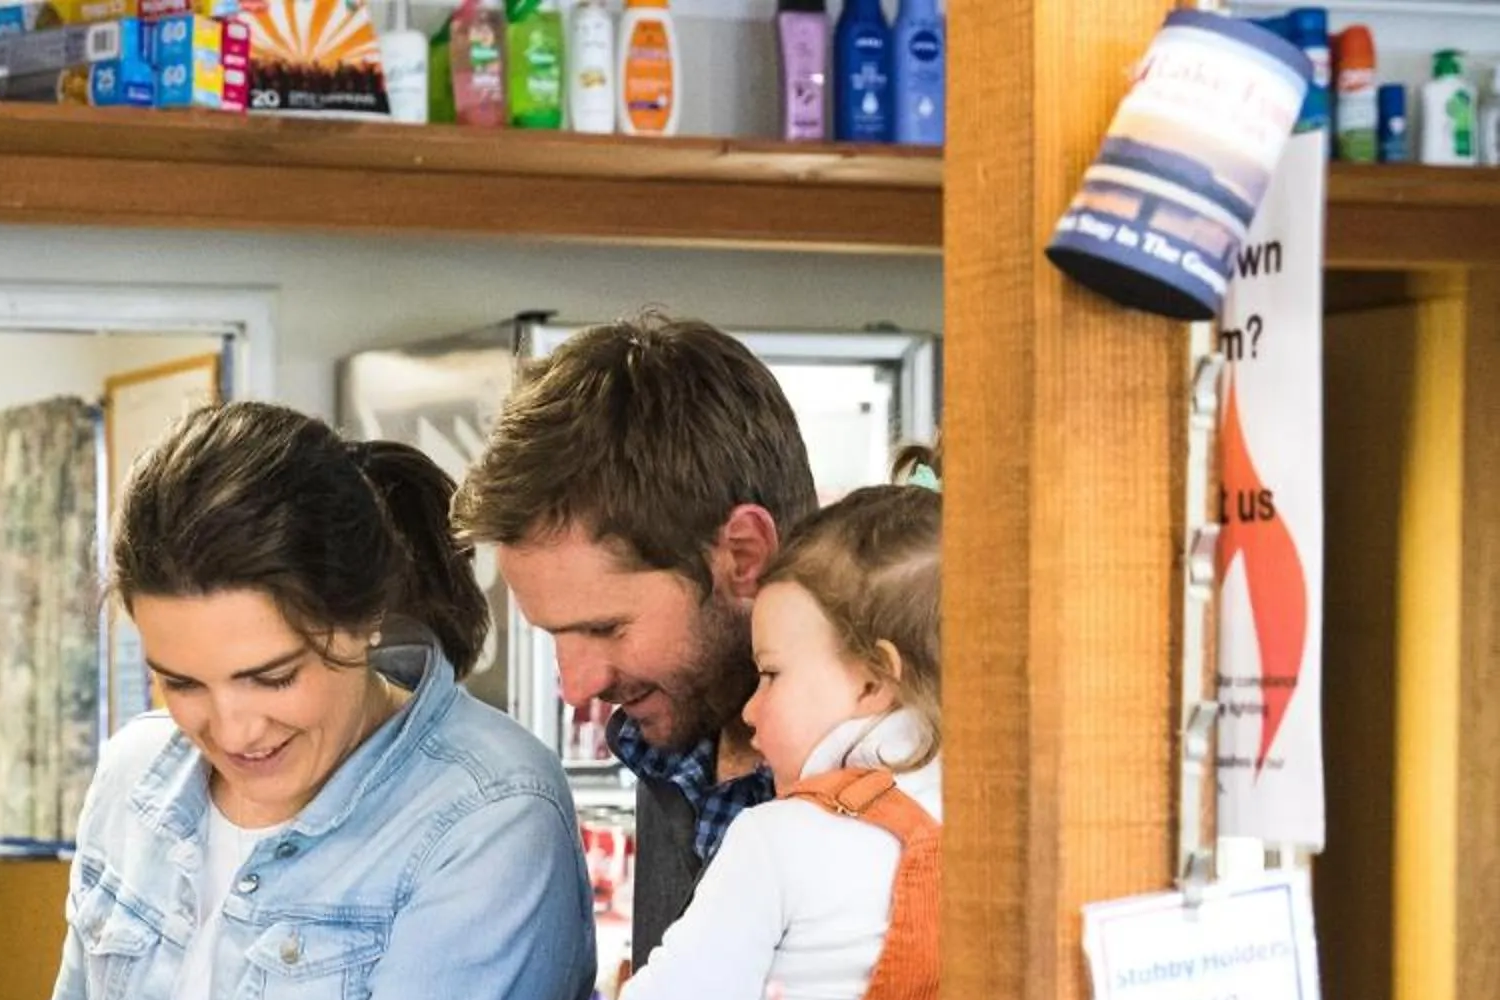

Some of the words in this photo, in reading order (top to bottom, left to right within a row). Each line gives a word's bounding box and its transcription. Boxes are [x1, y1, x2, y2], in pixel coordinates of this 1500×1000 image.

[251, 89, 281, 109] 20
[1224, 240, 1283, 279] wn
[1237, 488, 1275, 523] us
